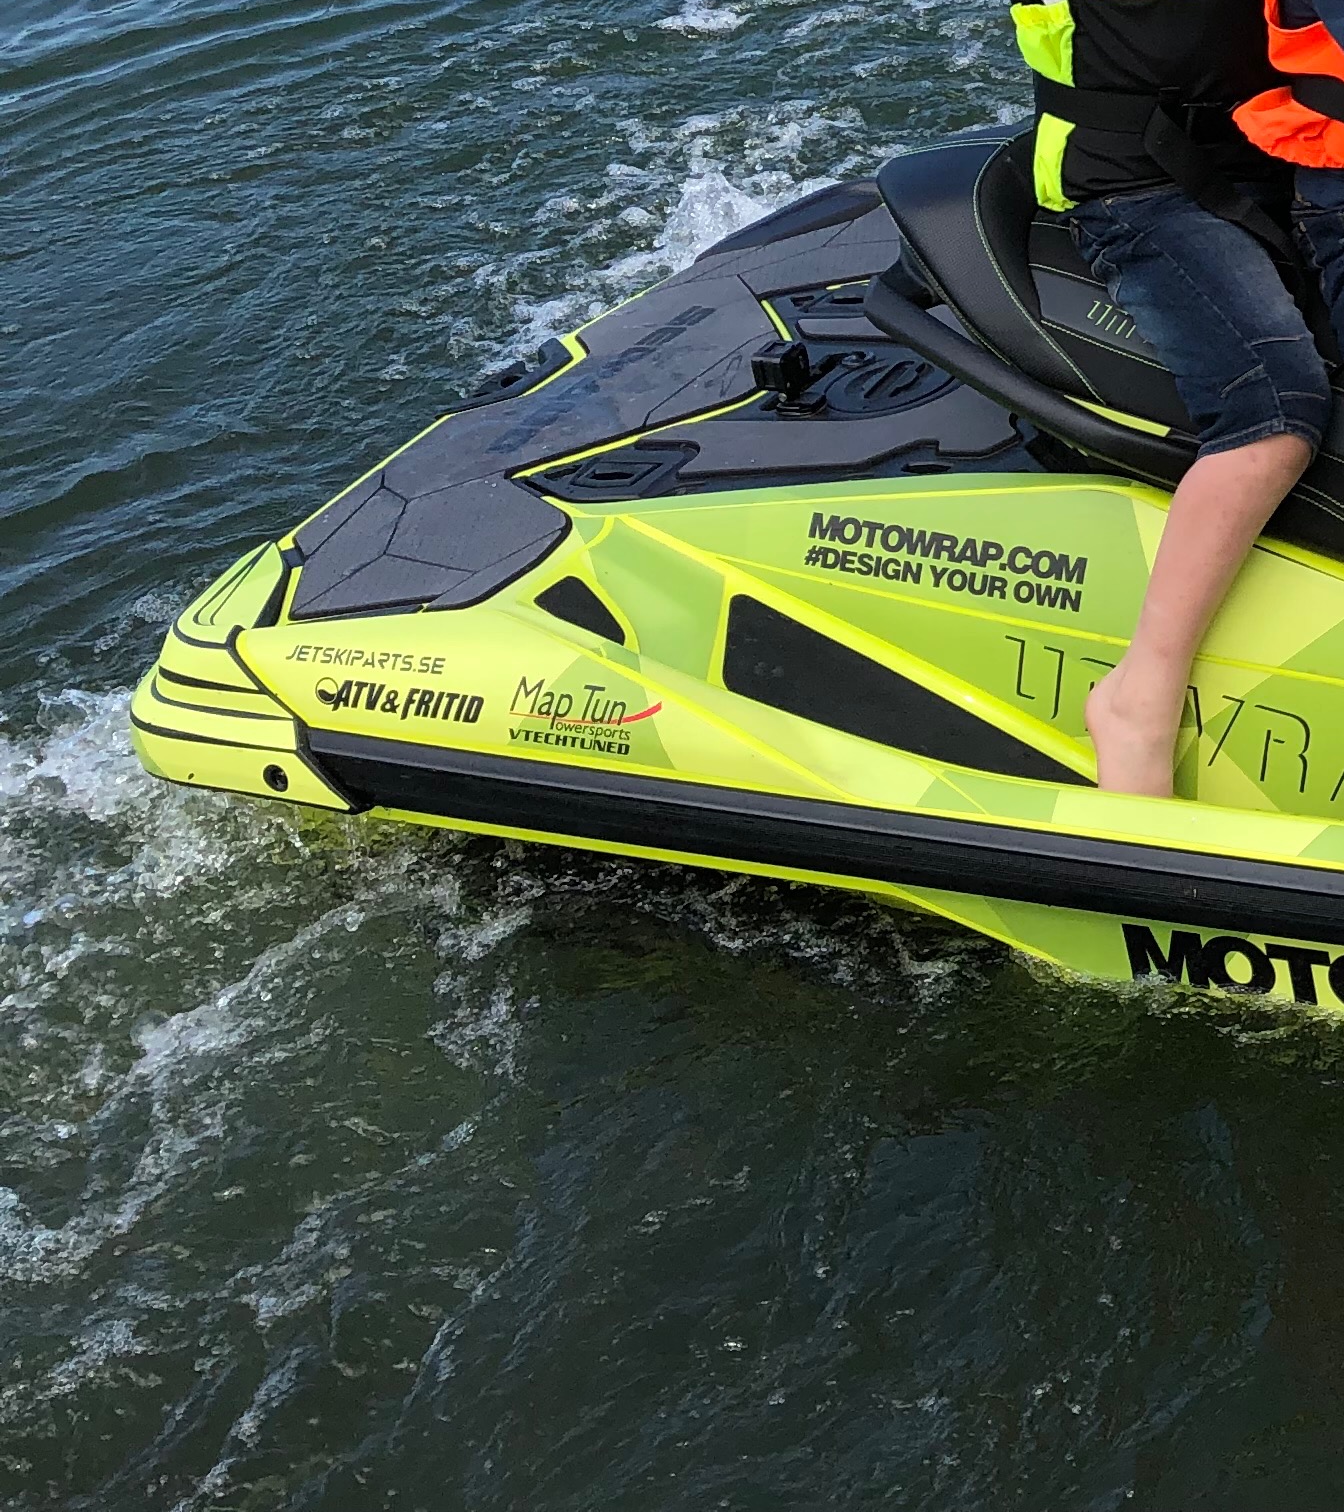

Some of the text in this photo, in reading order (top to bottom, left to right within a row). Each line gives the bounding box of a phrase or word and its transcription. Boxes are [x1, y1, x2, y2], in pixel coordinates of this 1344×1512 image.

[808, 512, 1088, 585] MOTOWRAP.COM
[804, 545, 1082, 613] #DESIGN YOUR OWN
[286, 645, 446, 675] JETSKIPARTS.SE
[510, 676, 627, 729] Map Tun
